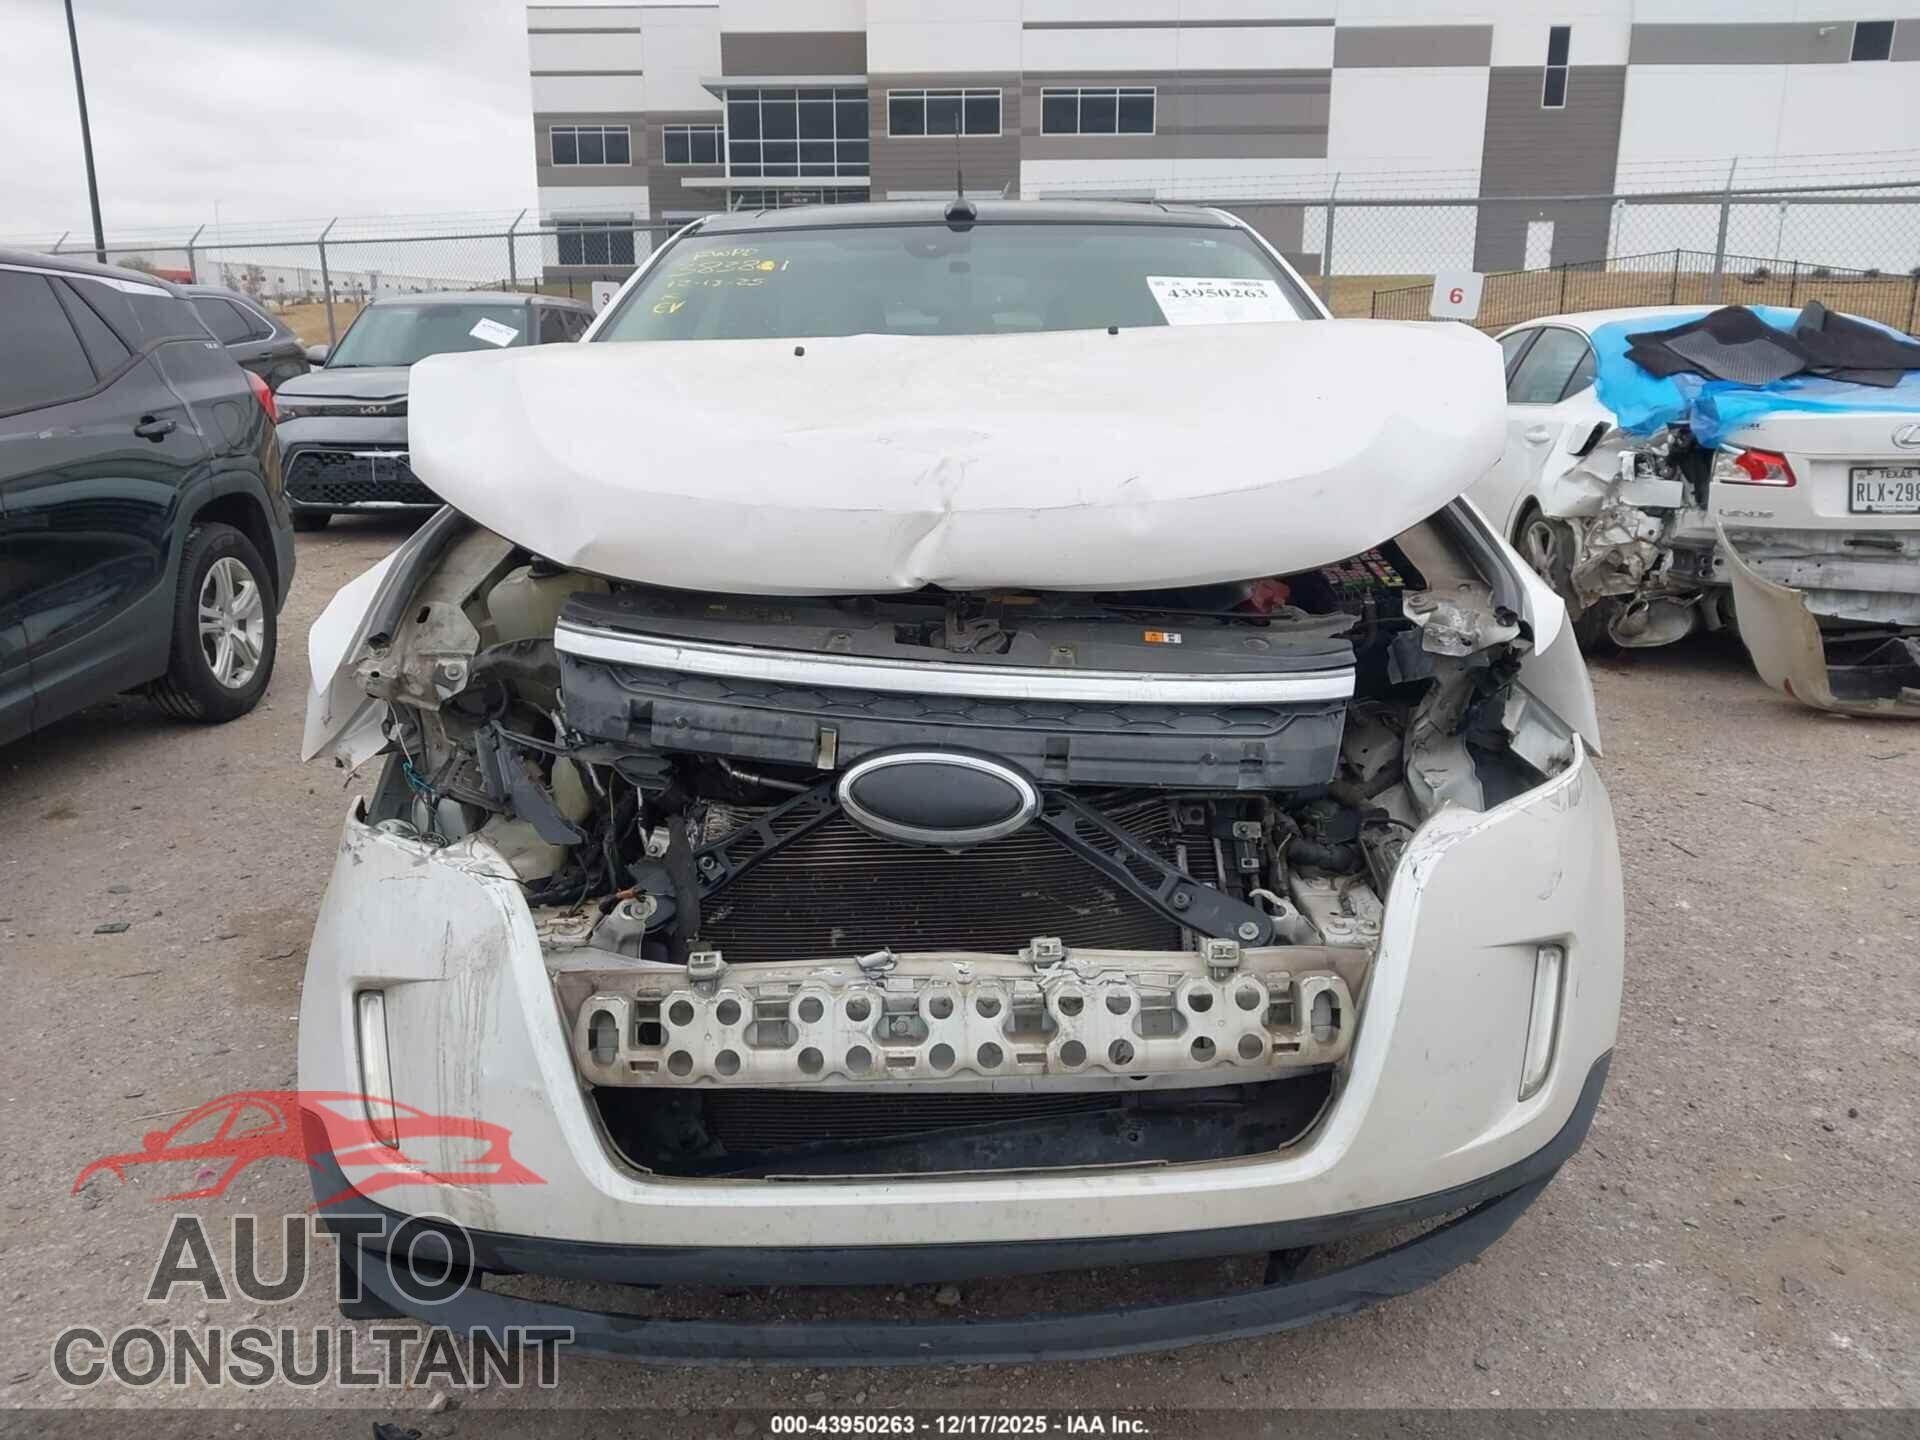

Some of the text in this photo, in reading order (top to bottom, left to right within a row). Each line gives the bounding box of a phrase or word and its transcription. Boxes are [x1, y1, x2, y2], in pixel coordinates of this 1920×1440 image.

[602, 292, 610, 306] 3
[1167, 288, 1269, 299] 43950263
[1449, 287, 1465, 305] 6
[1880, 470, 1912, 478] TEXAS
